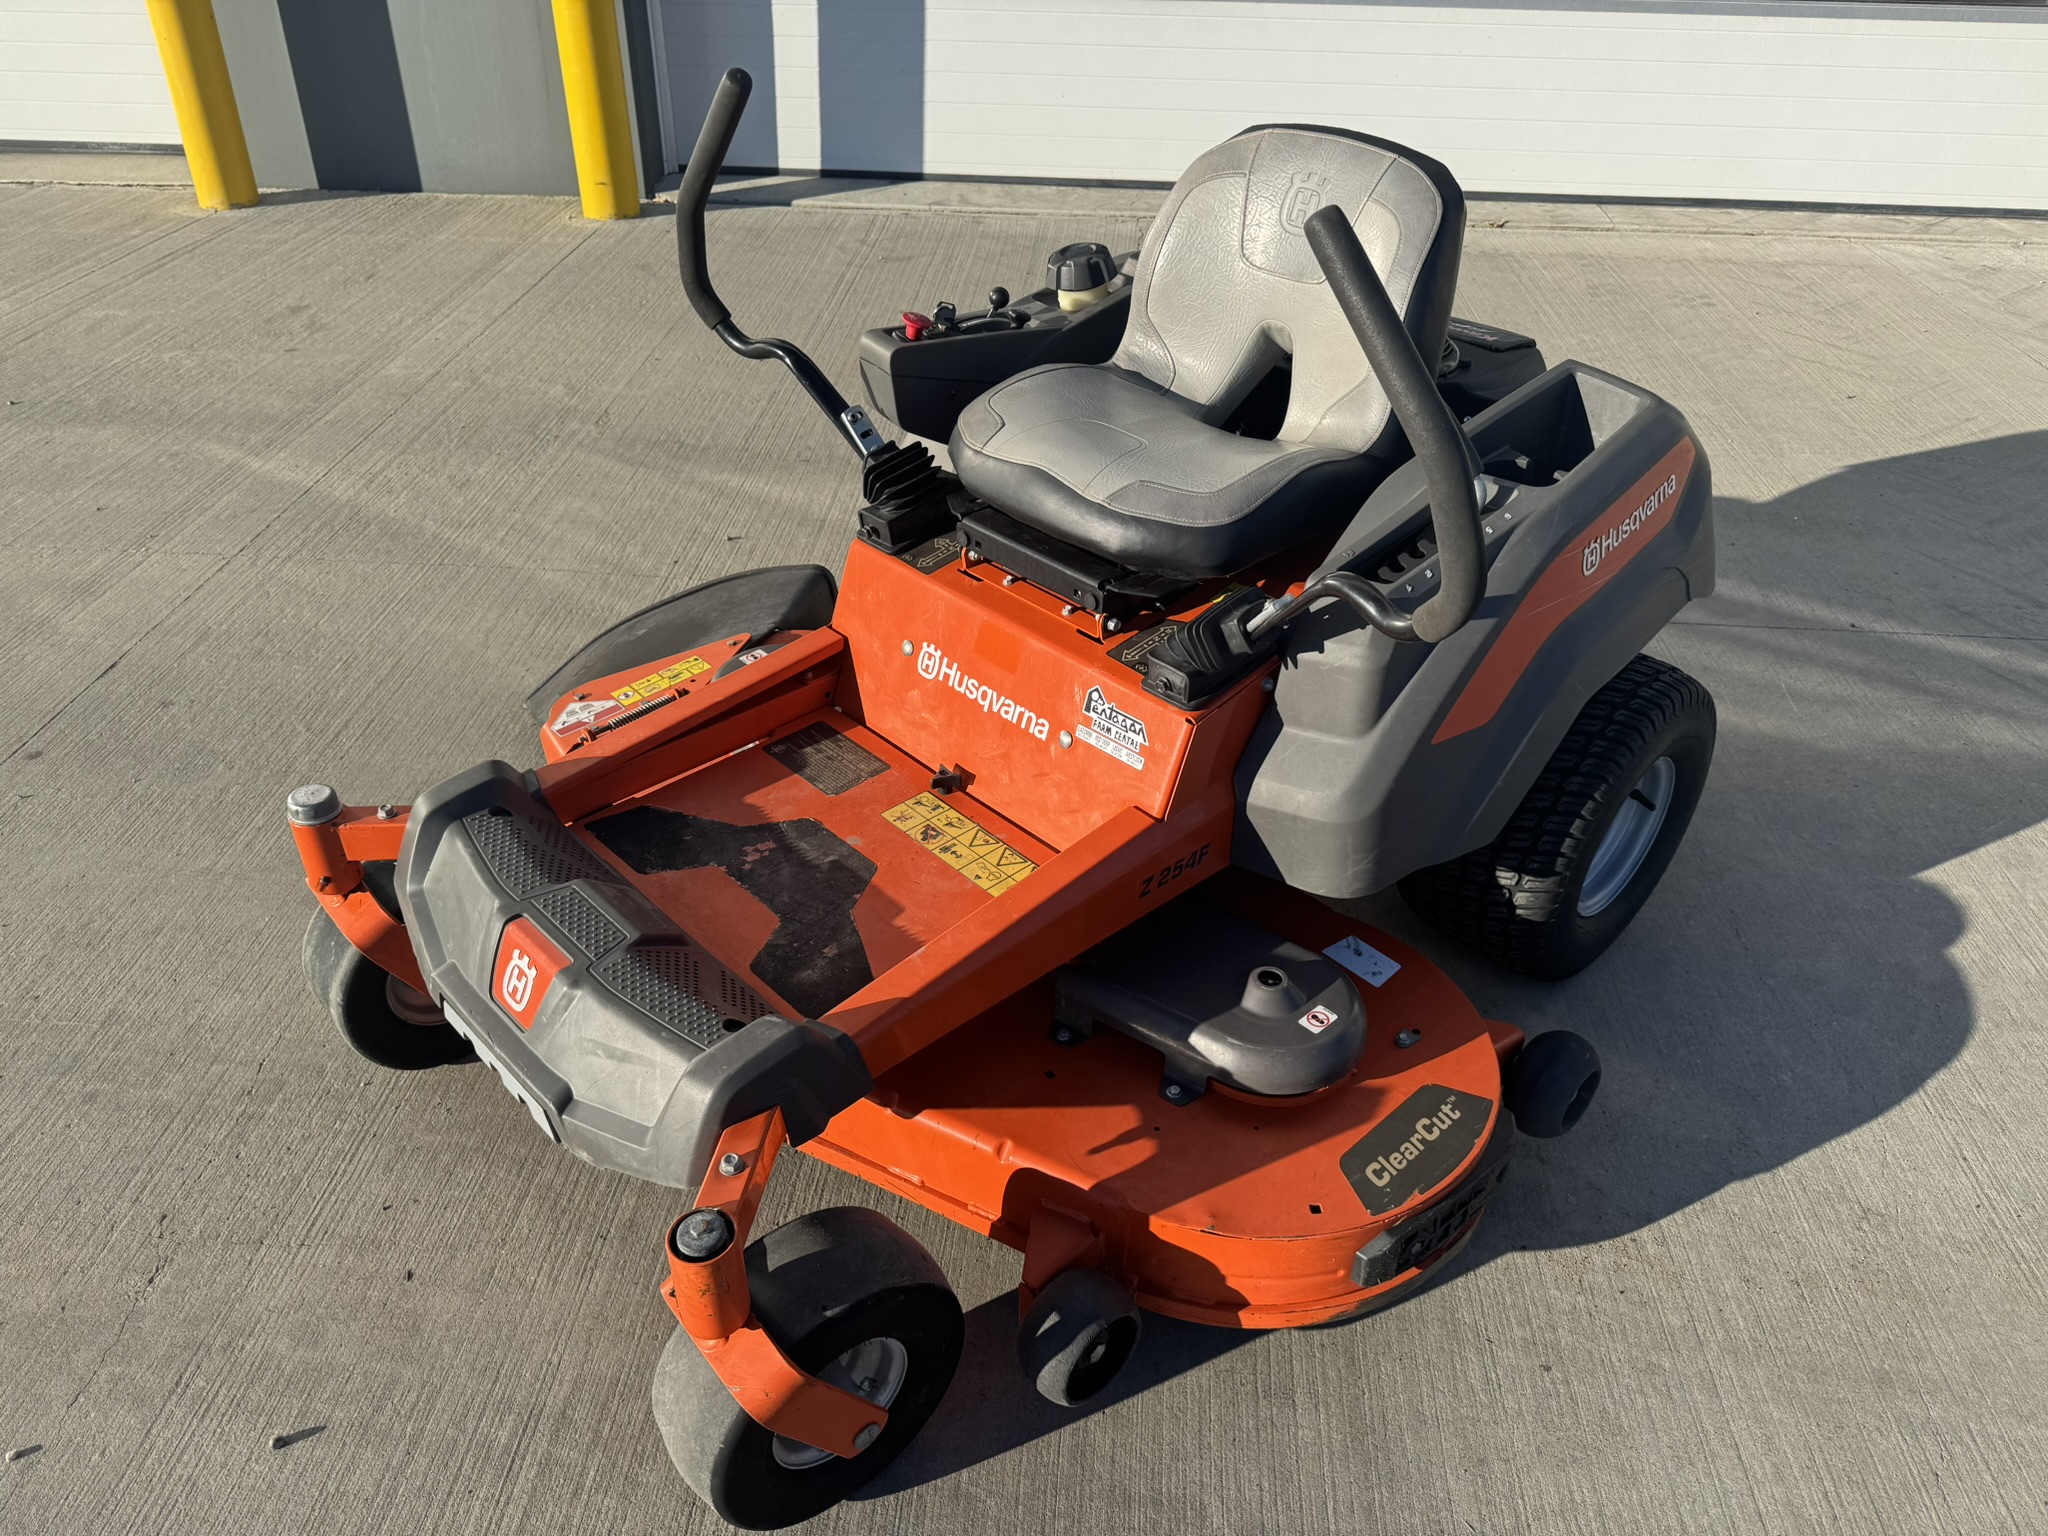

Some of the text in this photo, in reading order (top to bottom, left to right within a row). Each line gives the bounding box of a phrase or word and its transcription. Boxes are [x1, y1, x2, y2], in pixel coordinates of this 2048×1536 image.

[1601, 474, 1676, 558] Husqvarna
[938, 656, 1050, 741] Husqvarna
[1084, 687, 1147, 743] Pentagon
[1093, 719, 1112, 736] FARM
[1114, 730, 1139, 750] CENTRE
[1138, 842, 1211, 899] Z 254F
